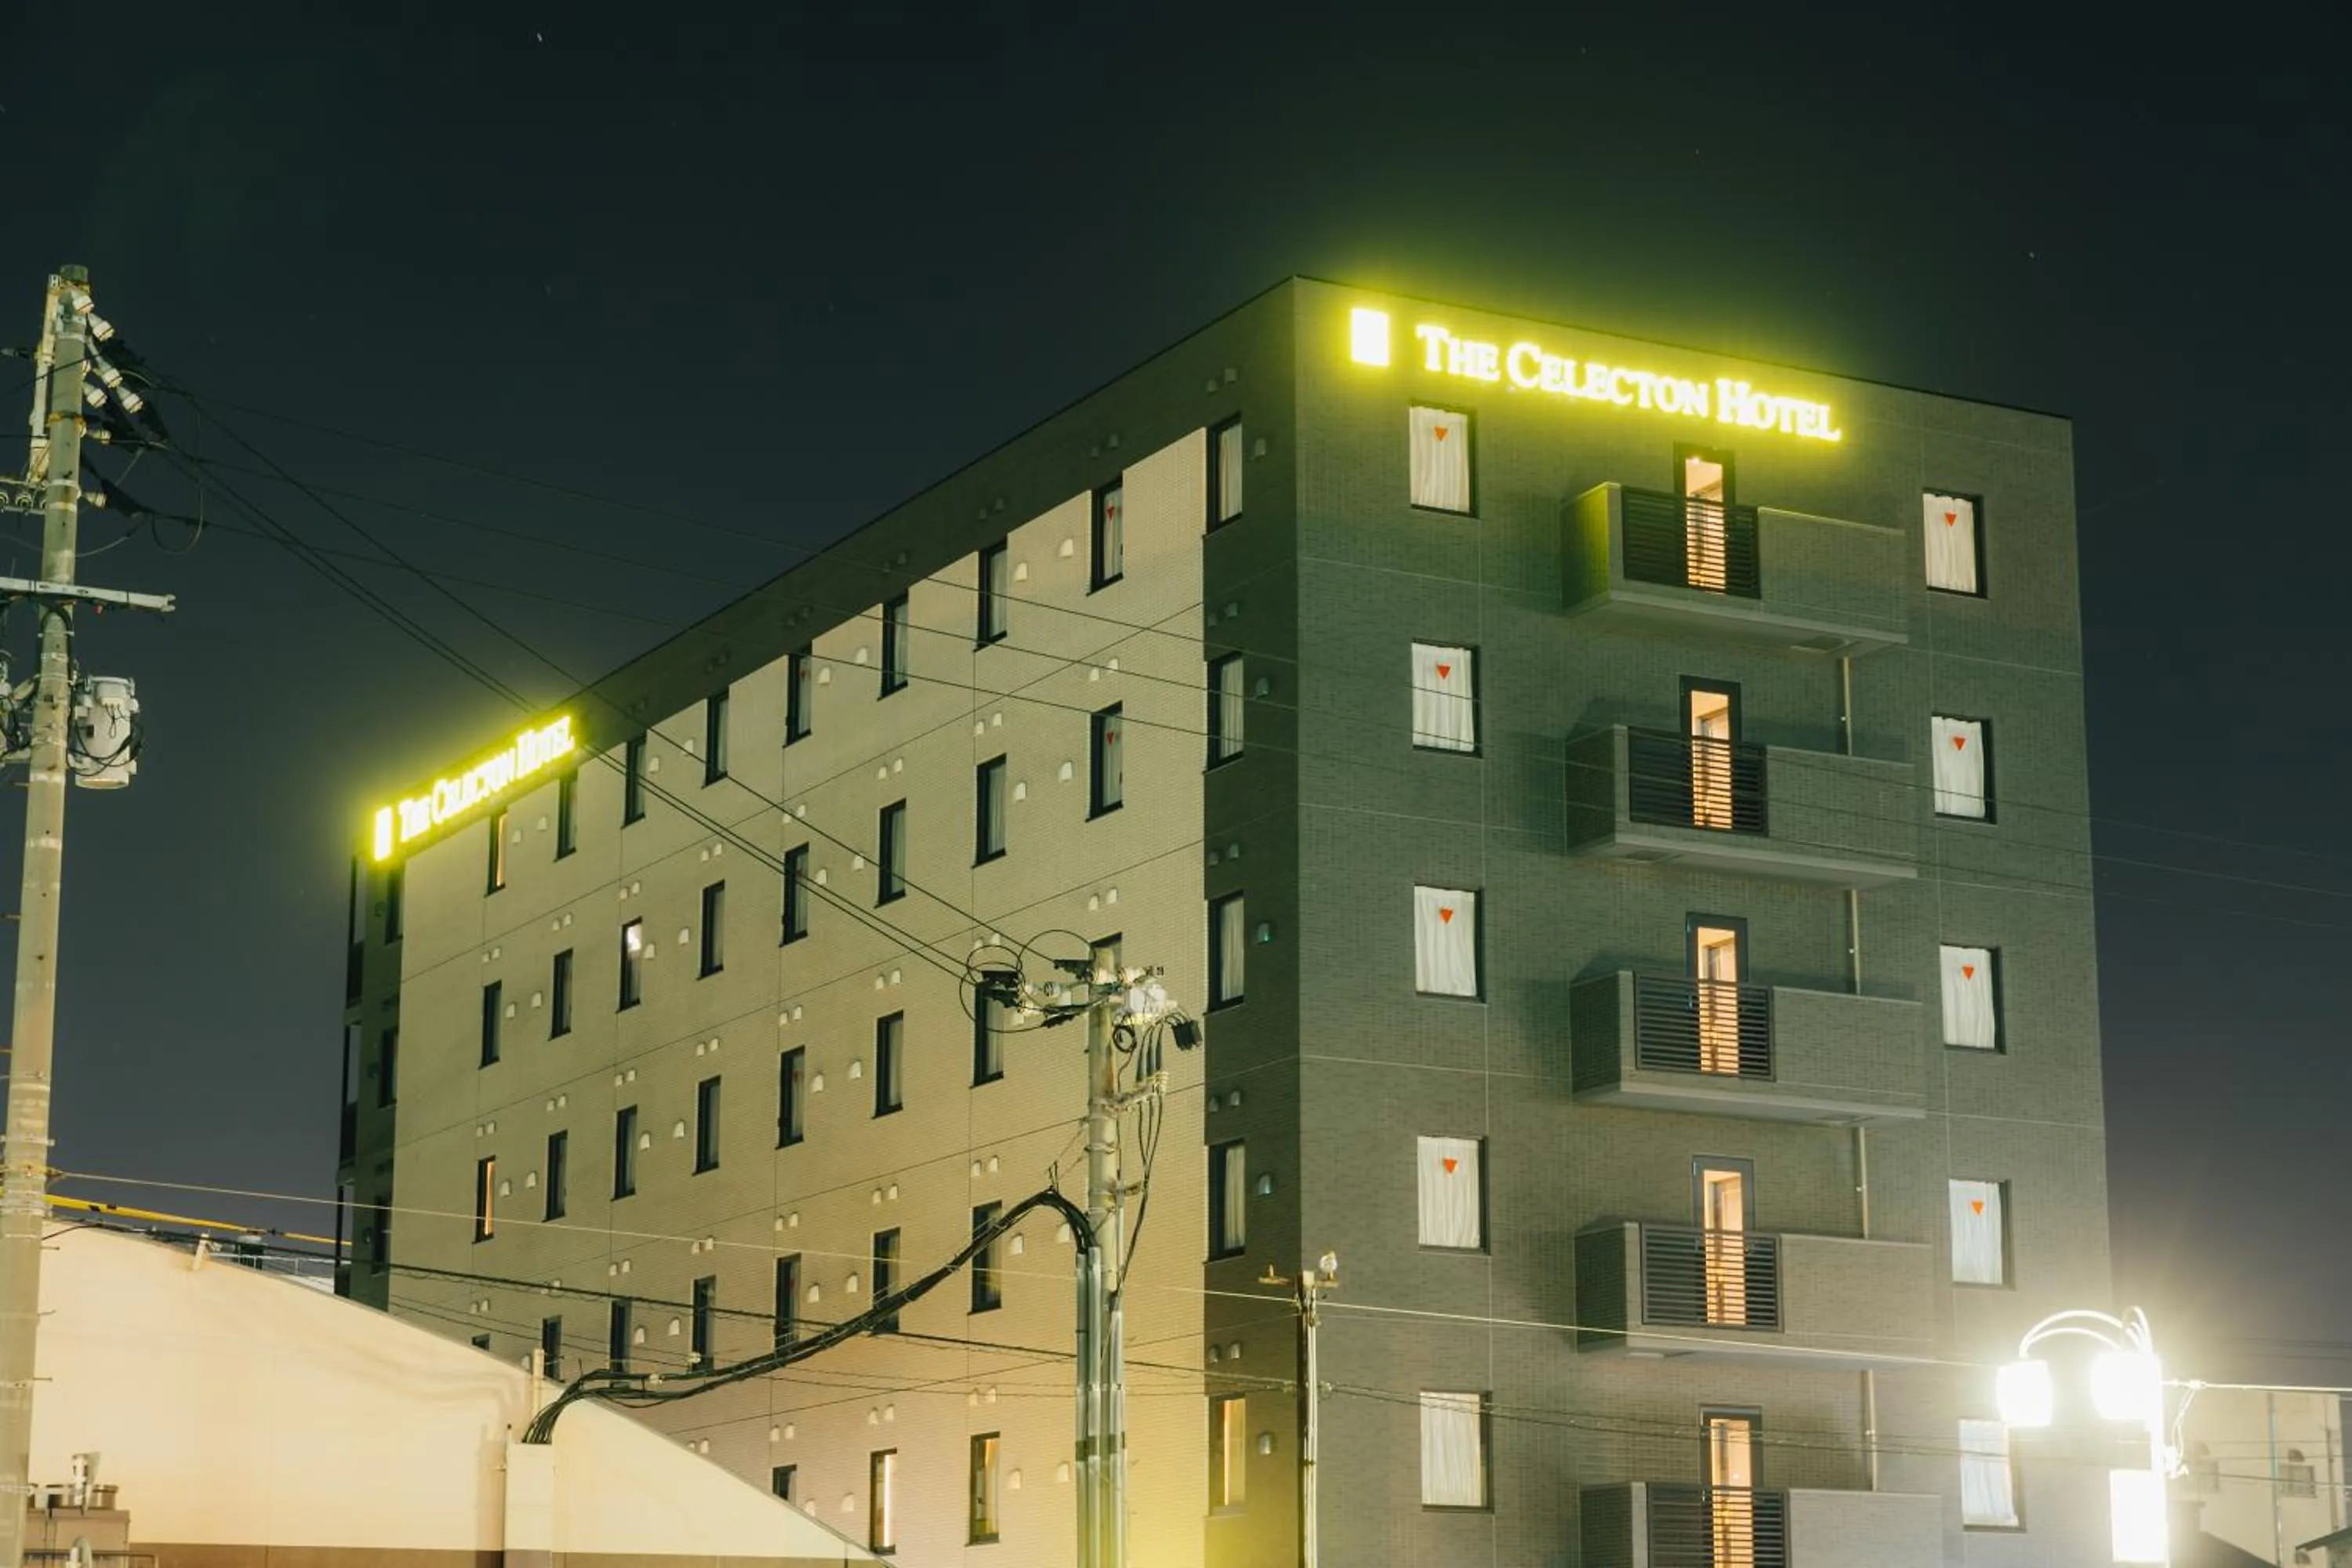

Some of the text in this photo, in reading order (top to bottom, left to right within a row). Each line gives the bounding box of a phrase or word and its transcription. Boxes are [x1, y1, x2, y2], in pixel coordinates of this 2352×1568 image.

[1416, 324, 1842, 441] THE CELECTON HOTEL
